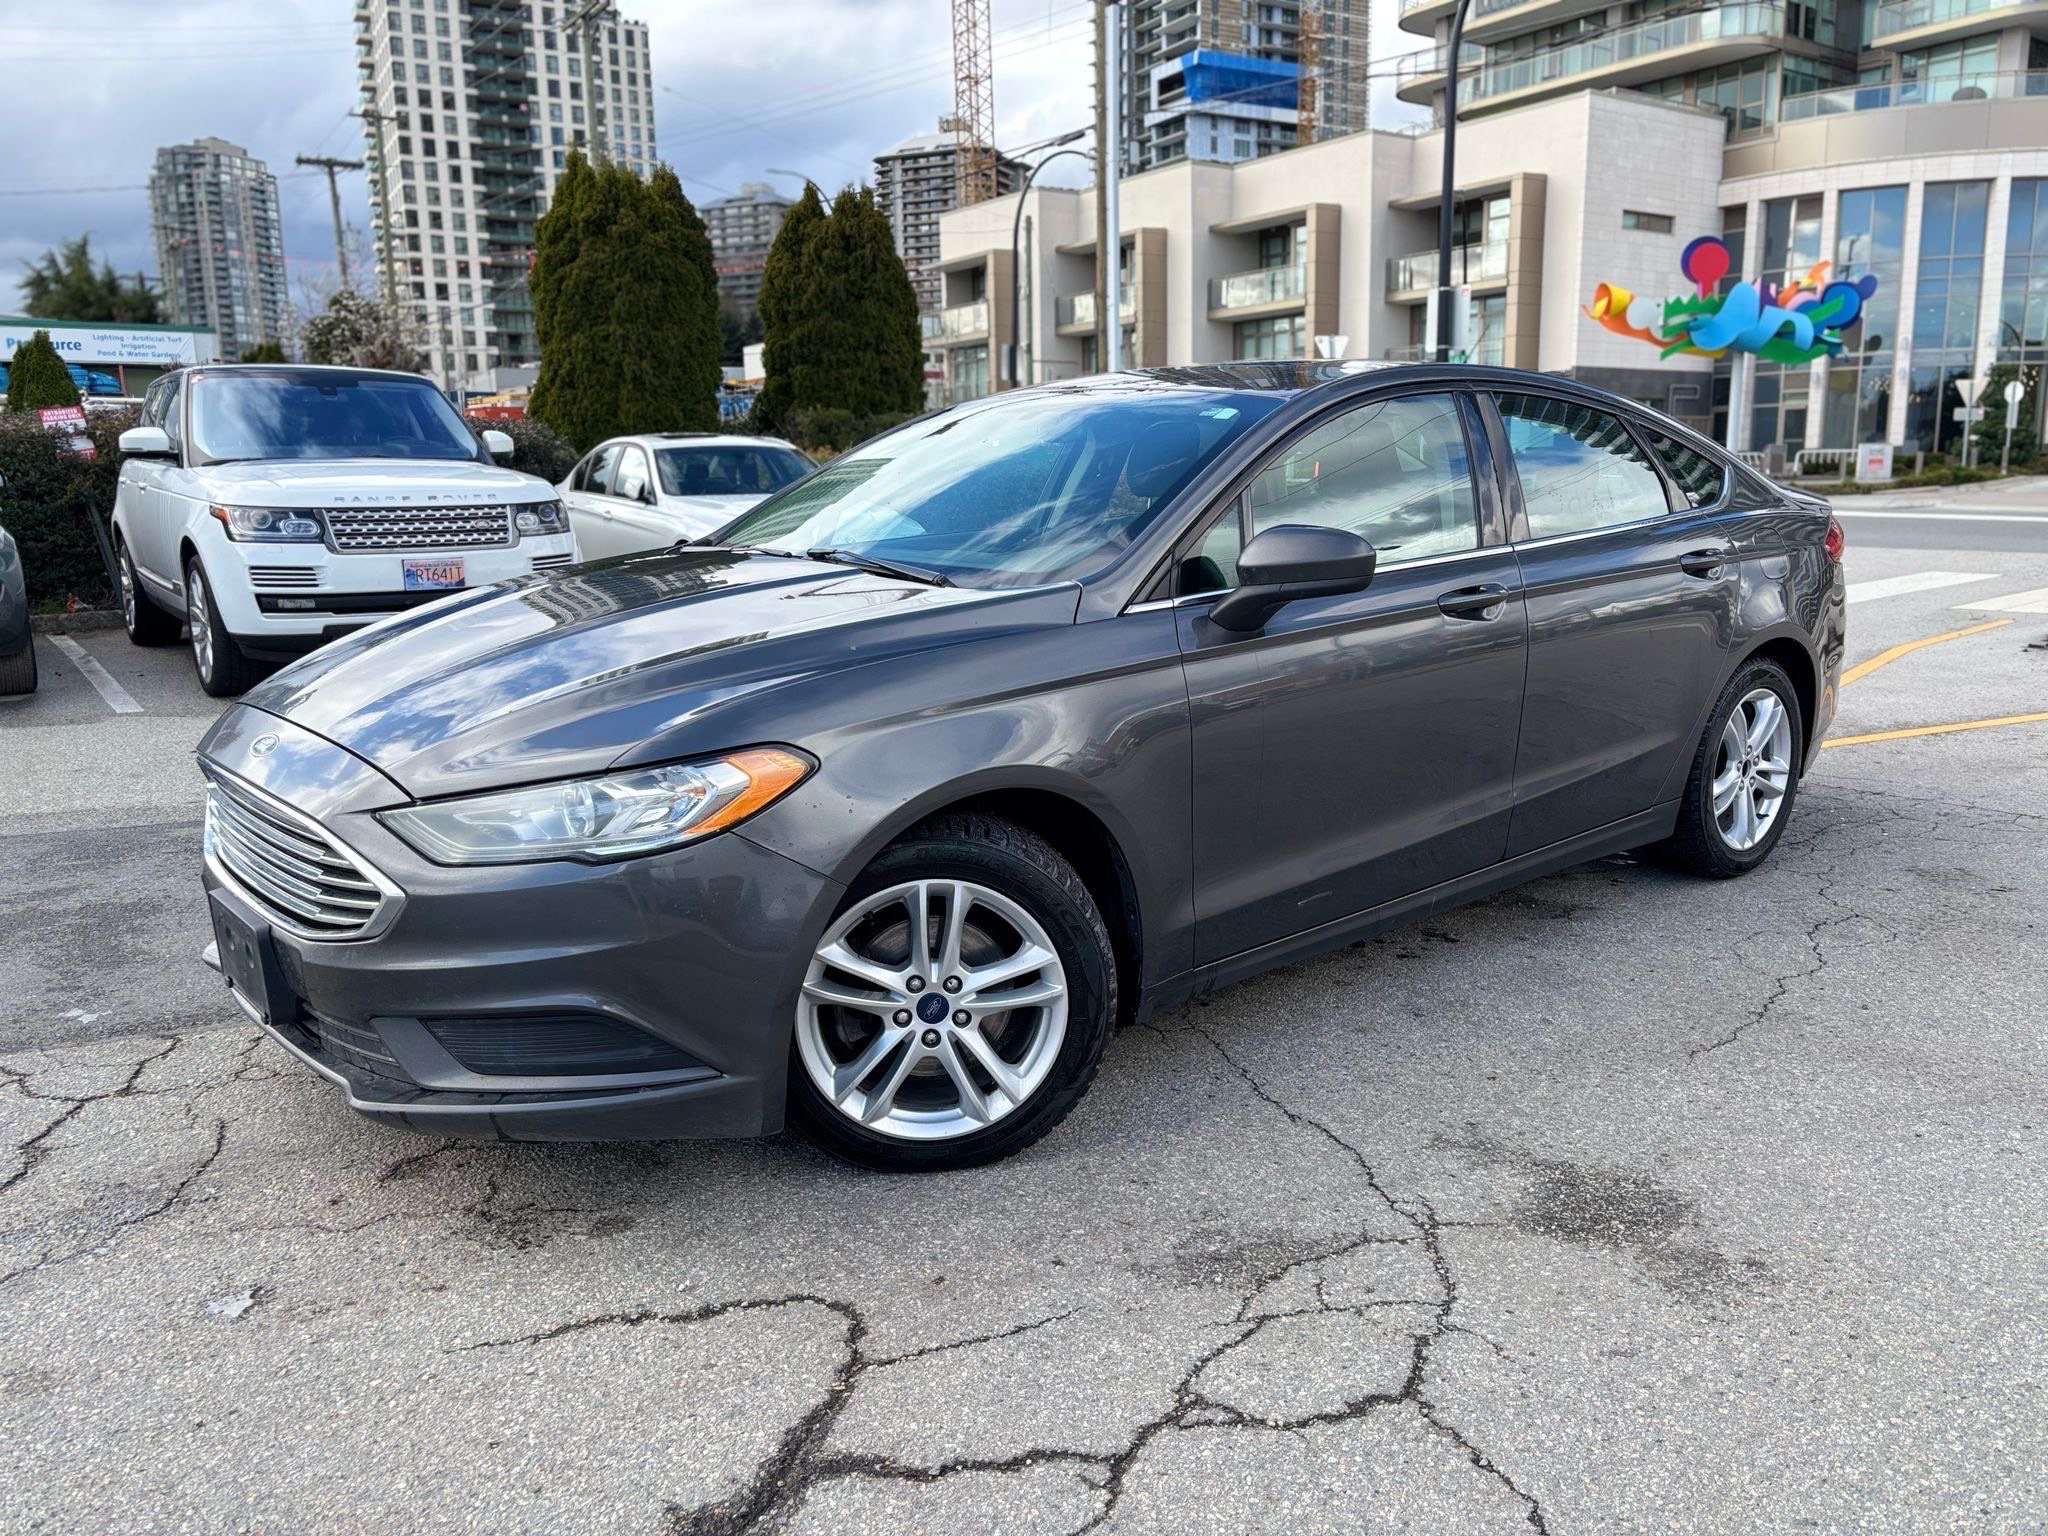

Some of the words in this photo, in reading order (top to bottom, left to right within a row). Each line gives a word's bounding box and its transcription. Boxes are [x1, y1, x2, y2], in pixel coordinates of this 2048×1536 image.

[92, 333, 124, 342] Lighting
[132, 334, 165, 342] Artificial
[43, 414, 67, 422] PARKING
[427, 493, 497, 501] ROVER
